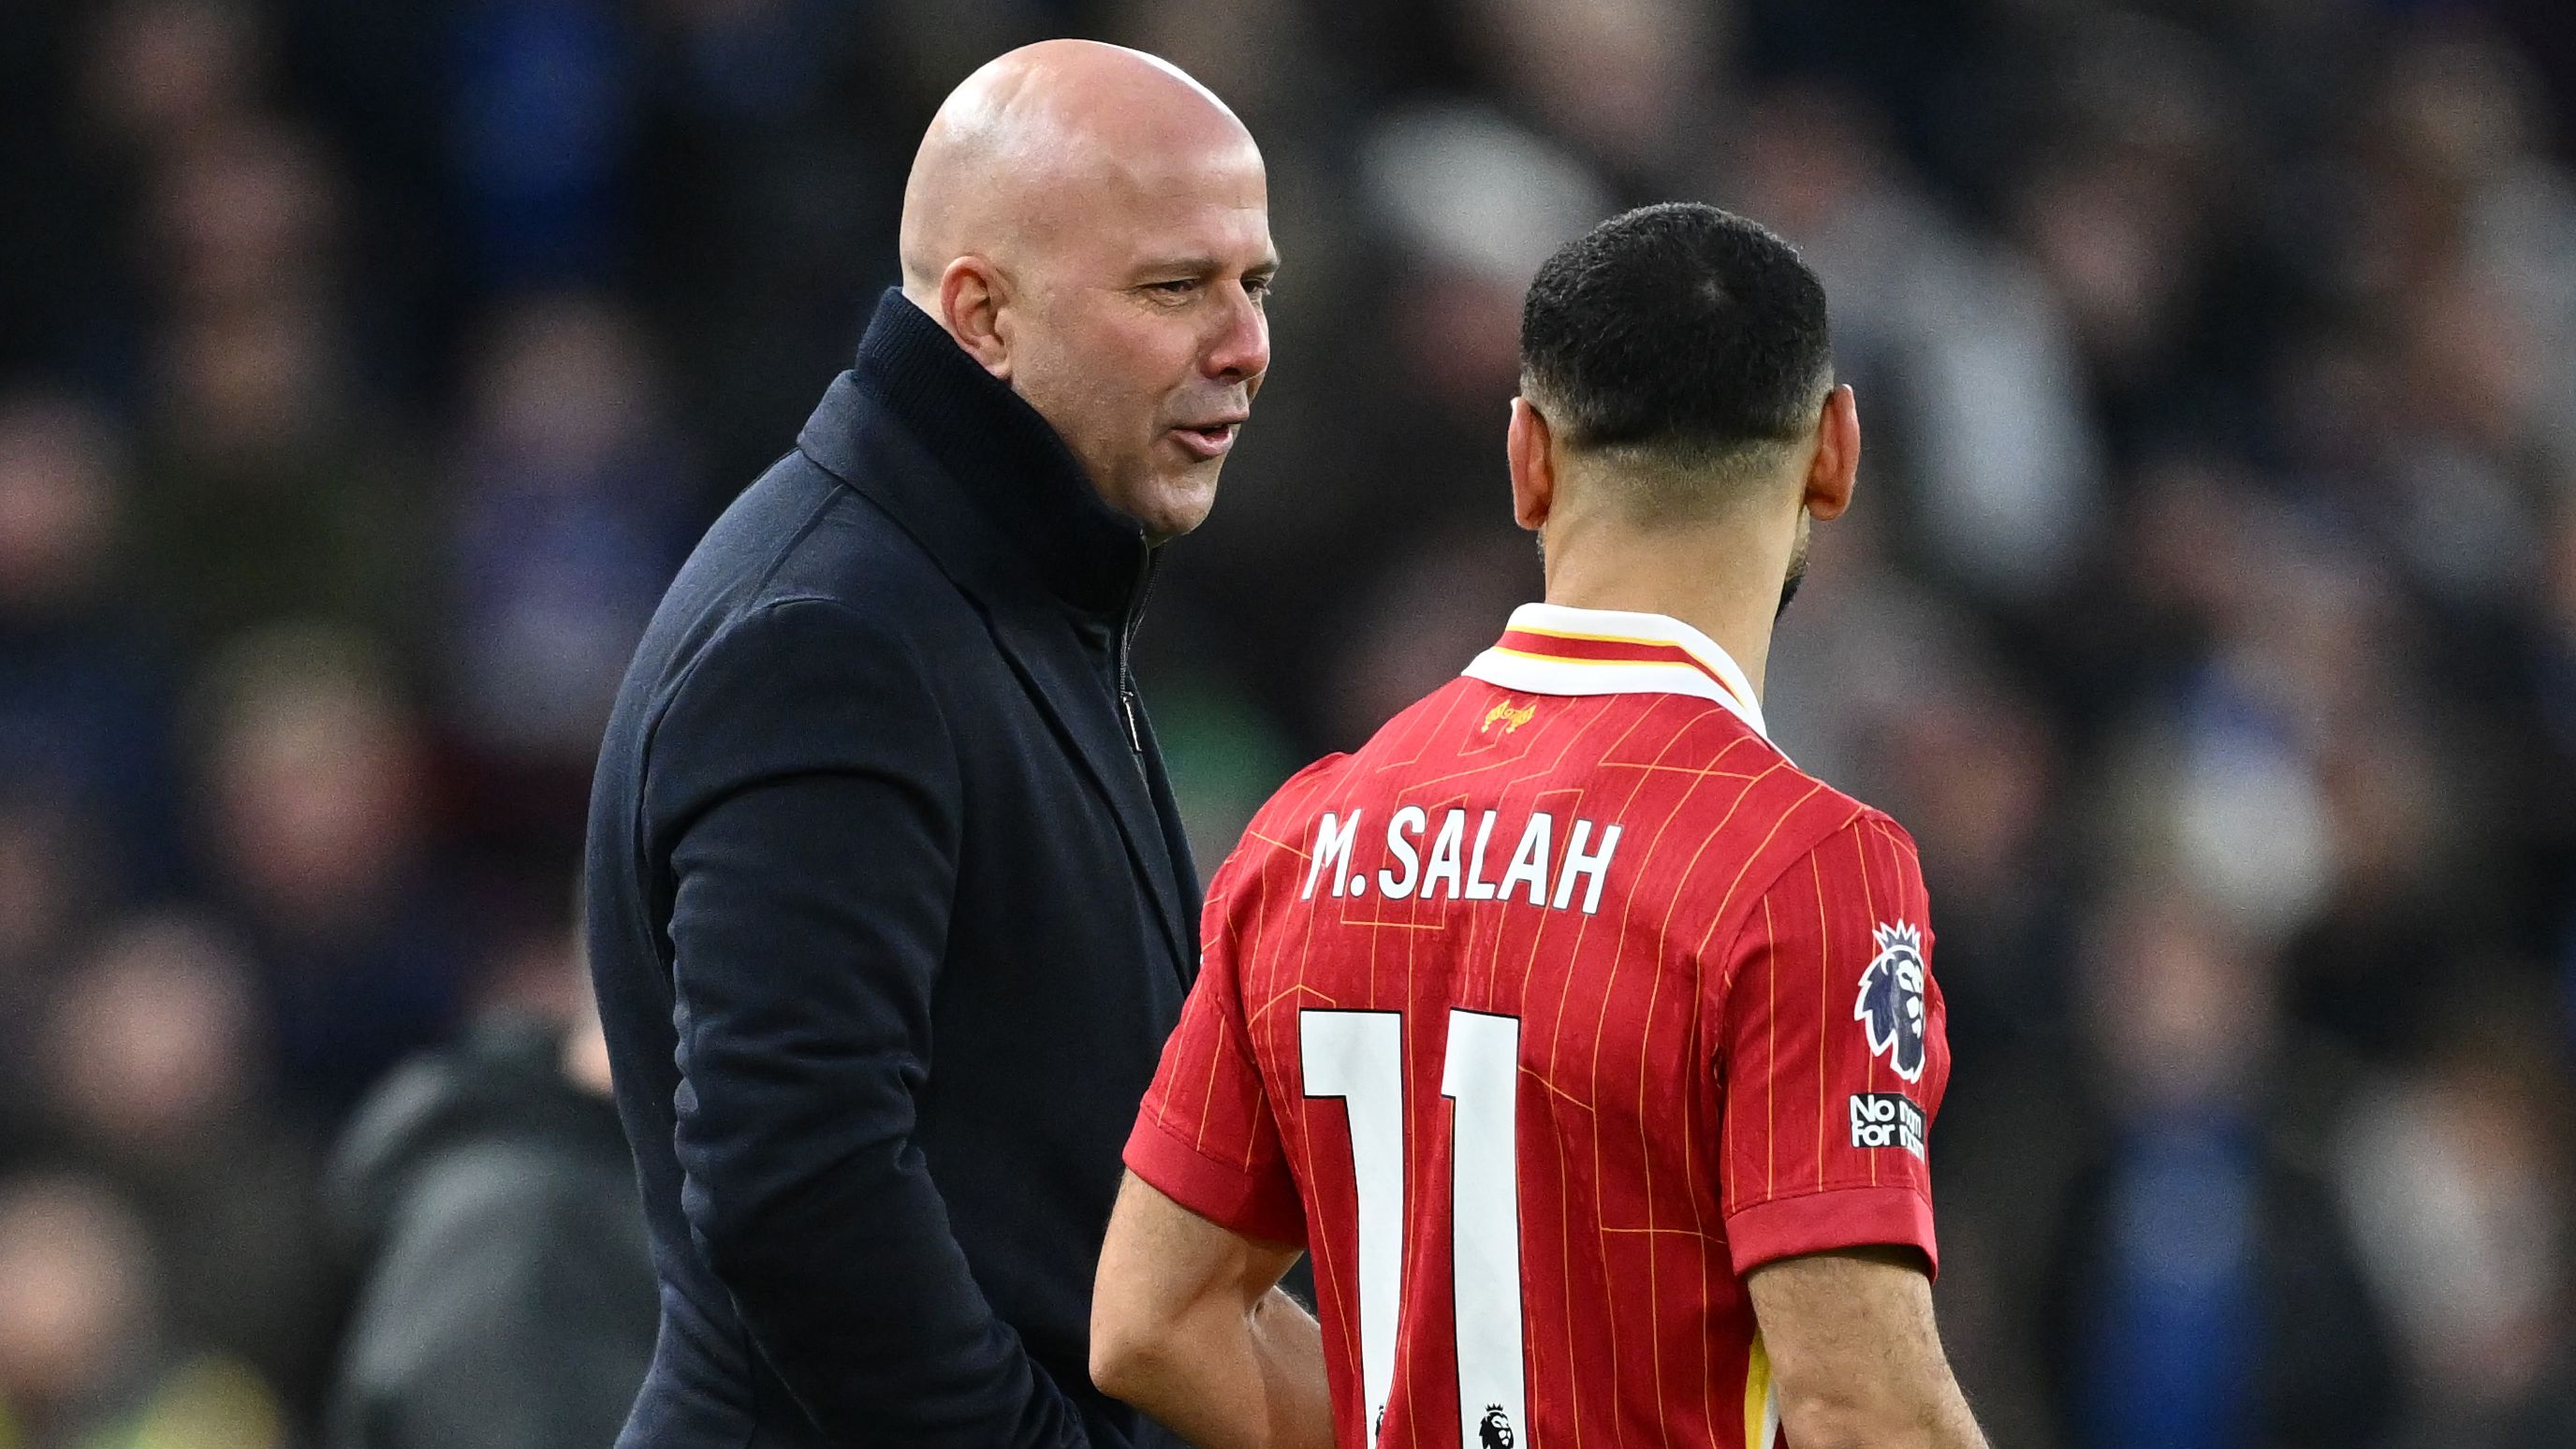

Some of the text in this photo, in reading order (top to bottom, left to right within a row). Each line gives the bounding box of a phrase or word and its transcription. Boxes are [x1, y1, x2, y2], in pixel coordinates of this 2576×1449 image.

[1850, 1093, 1895, 1122] No
[1852, 1120, 1895, 1148] for
[1298, 1006, 1528, 1449] 11
